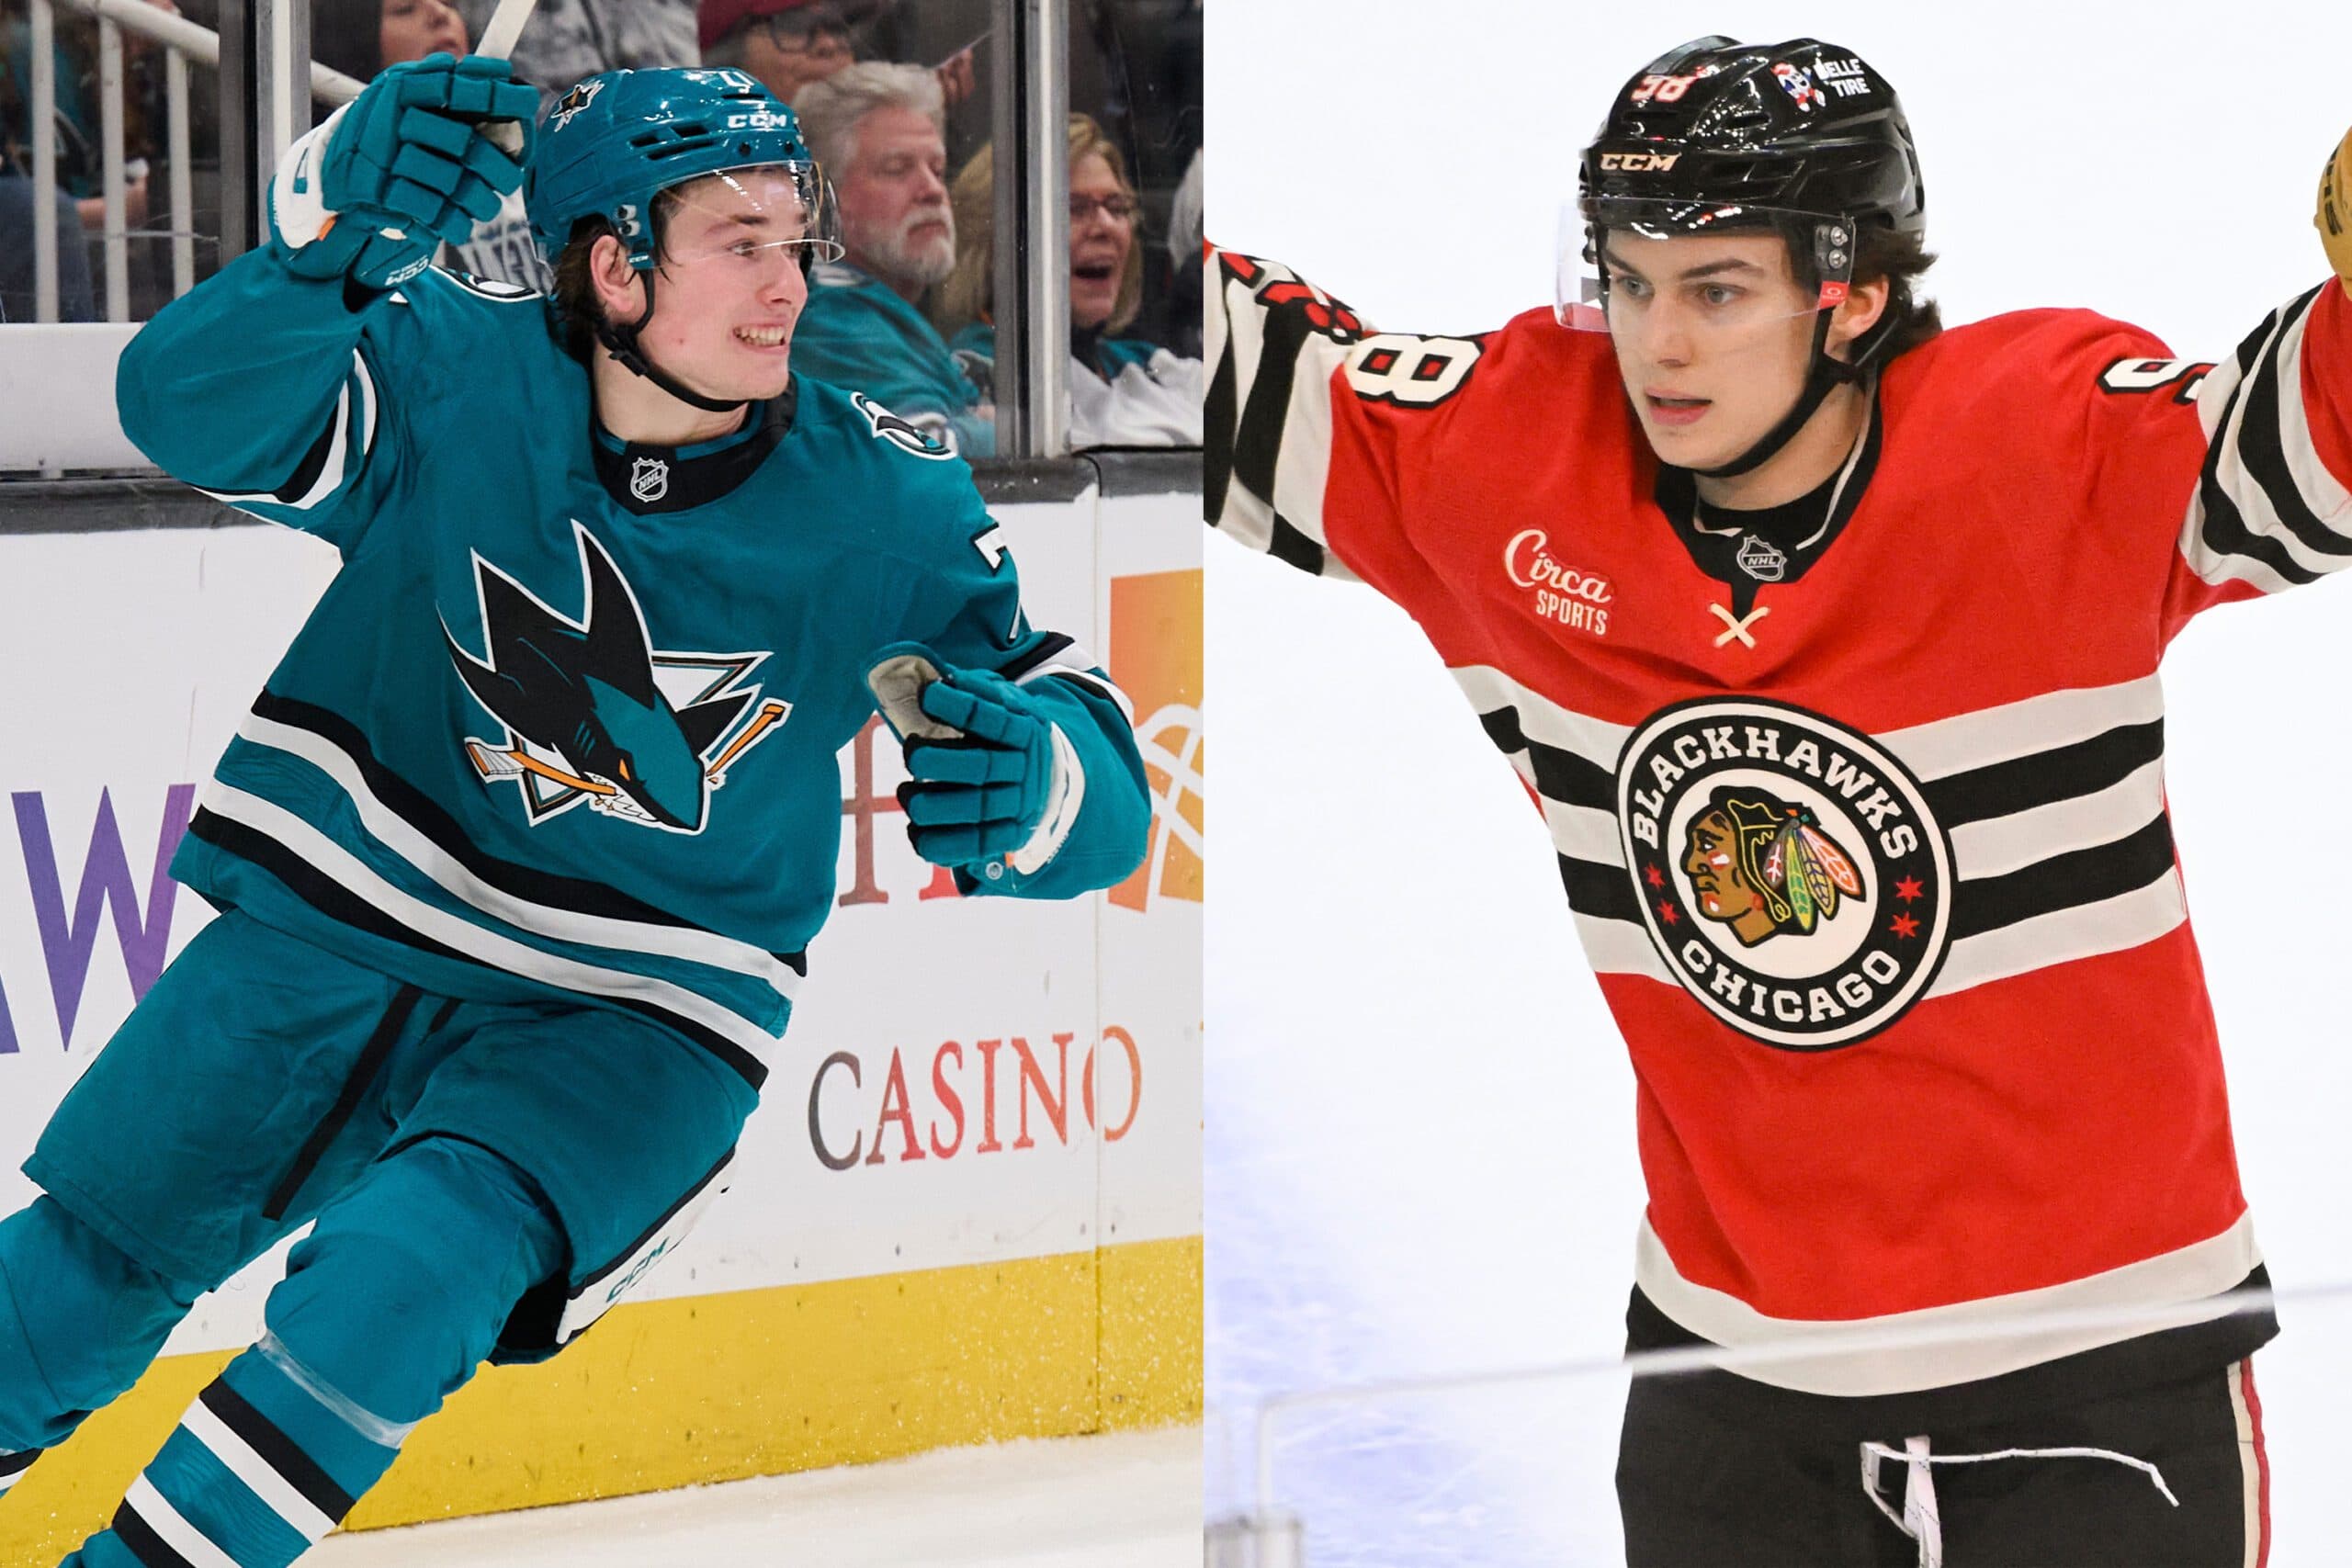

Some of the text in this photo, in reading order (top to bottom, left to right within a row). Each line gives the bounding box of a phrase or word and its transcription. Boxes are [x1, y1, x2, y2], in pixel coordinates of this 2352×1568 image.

[1829, 77, 1871, 97] TIRE
[727, 113, 787, 129] CCM
[1600, 152, 1679, 173] CCM
[1344, 333, 1485, 410] 8
[638, 470, 661, 491] NHL
[1504, 528, 1612, 604] Circa
[1747, 556, 1777, 566] NHL
[1535, 588, 1609, 636] SPORTS
[1633, 726, 1919, 861] BLACKHAWKS
[0, 784, 196, 1053] W
[1680, 939, 1901, 1023] CHICAGO
[808, 1024, 1143, 1172] CASINO
